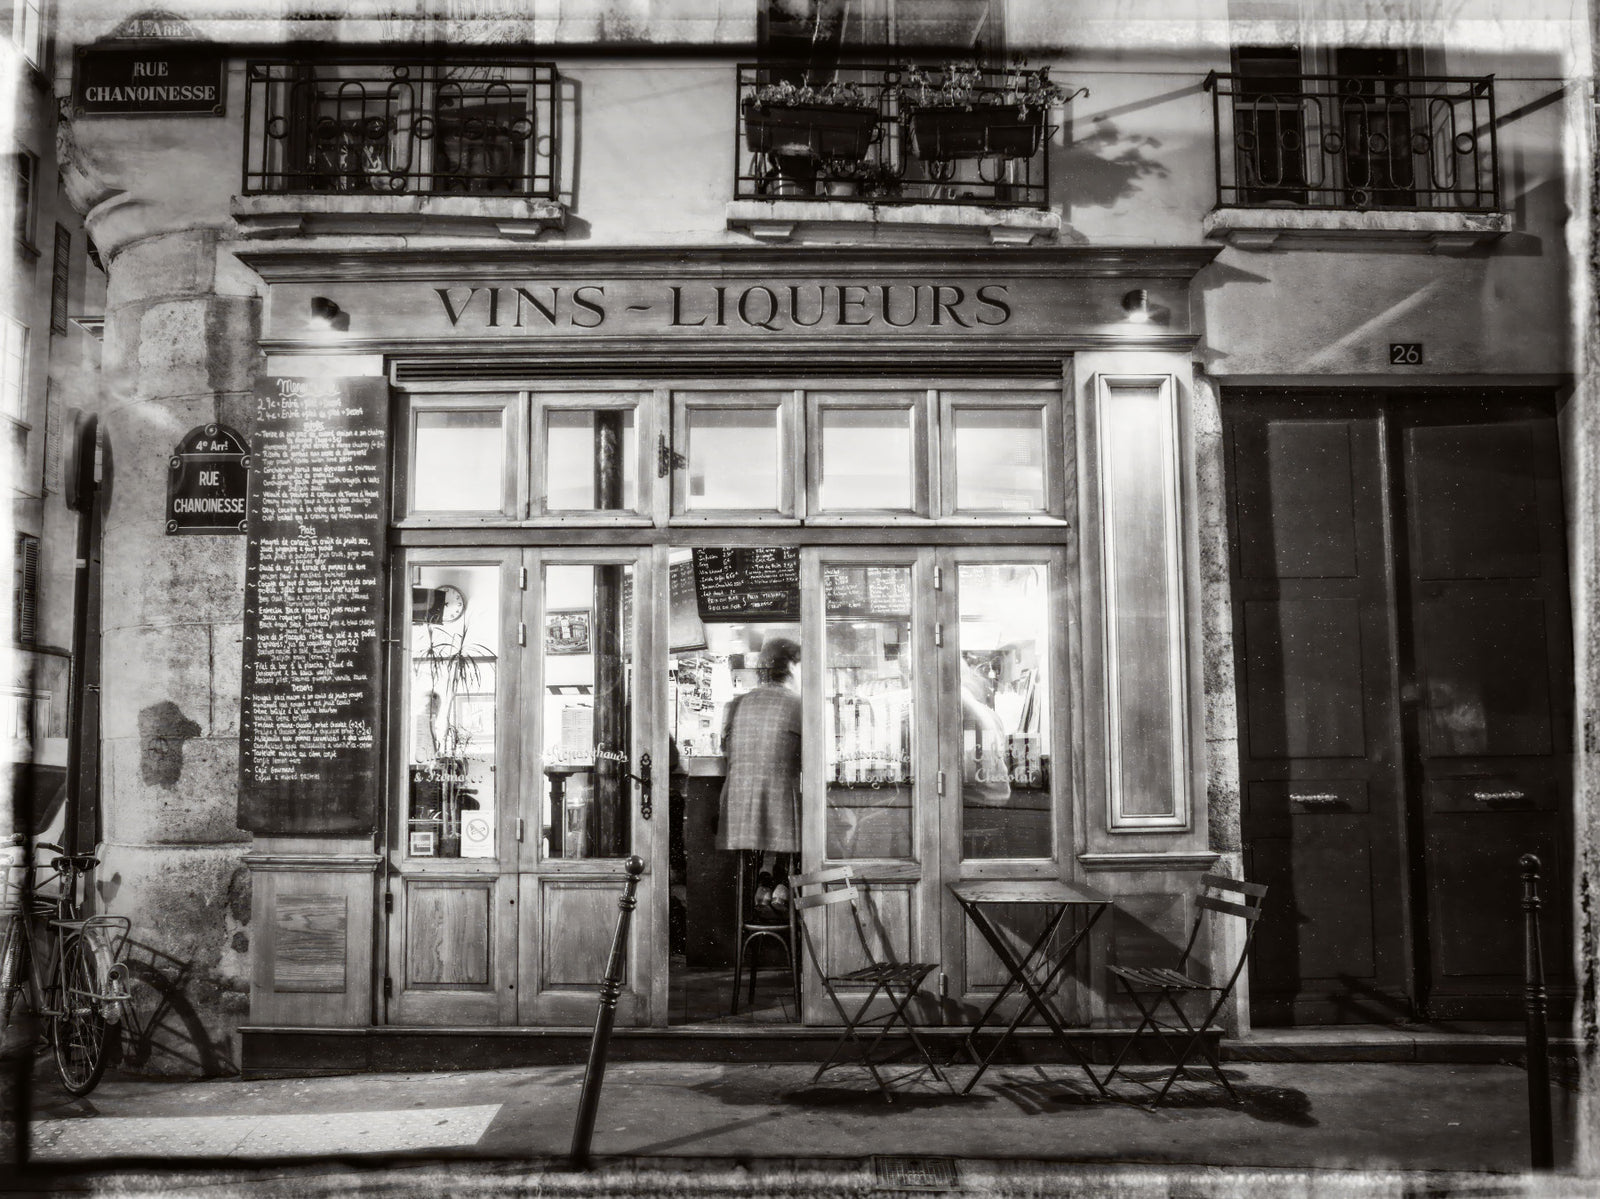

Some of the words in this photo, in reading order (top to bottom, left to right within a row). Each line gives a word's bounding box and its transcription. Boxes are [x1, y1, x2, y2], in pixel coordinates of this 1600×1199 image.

[134, 62, 169, 77] RUE
[85, 86, 216, 102] CHANOINESSE
[433, 286, 605, 327] VINS
[667, 285, 1010, 332] LIQUEURS
[1393, 345, 1419, 363] 26
[199, 471, 220, 486] RUE
[174, 498, 245, 513] CHANOINESSE
[974, 767, 1038, 784] Chocolat
